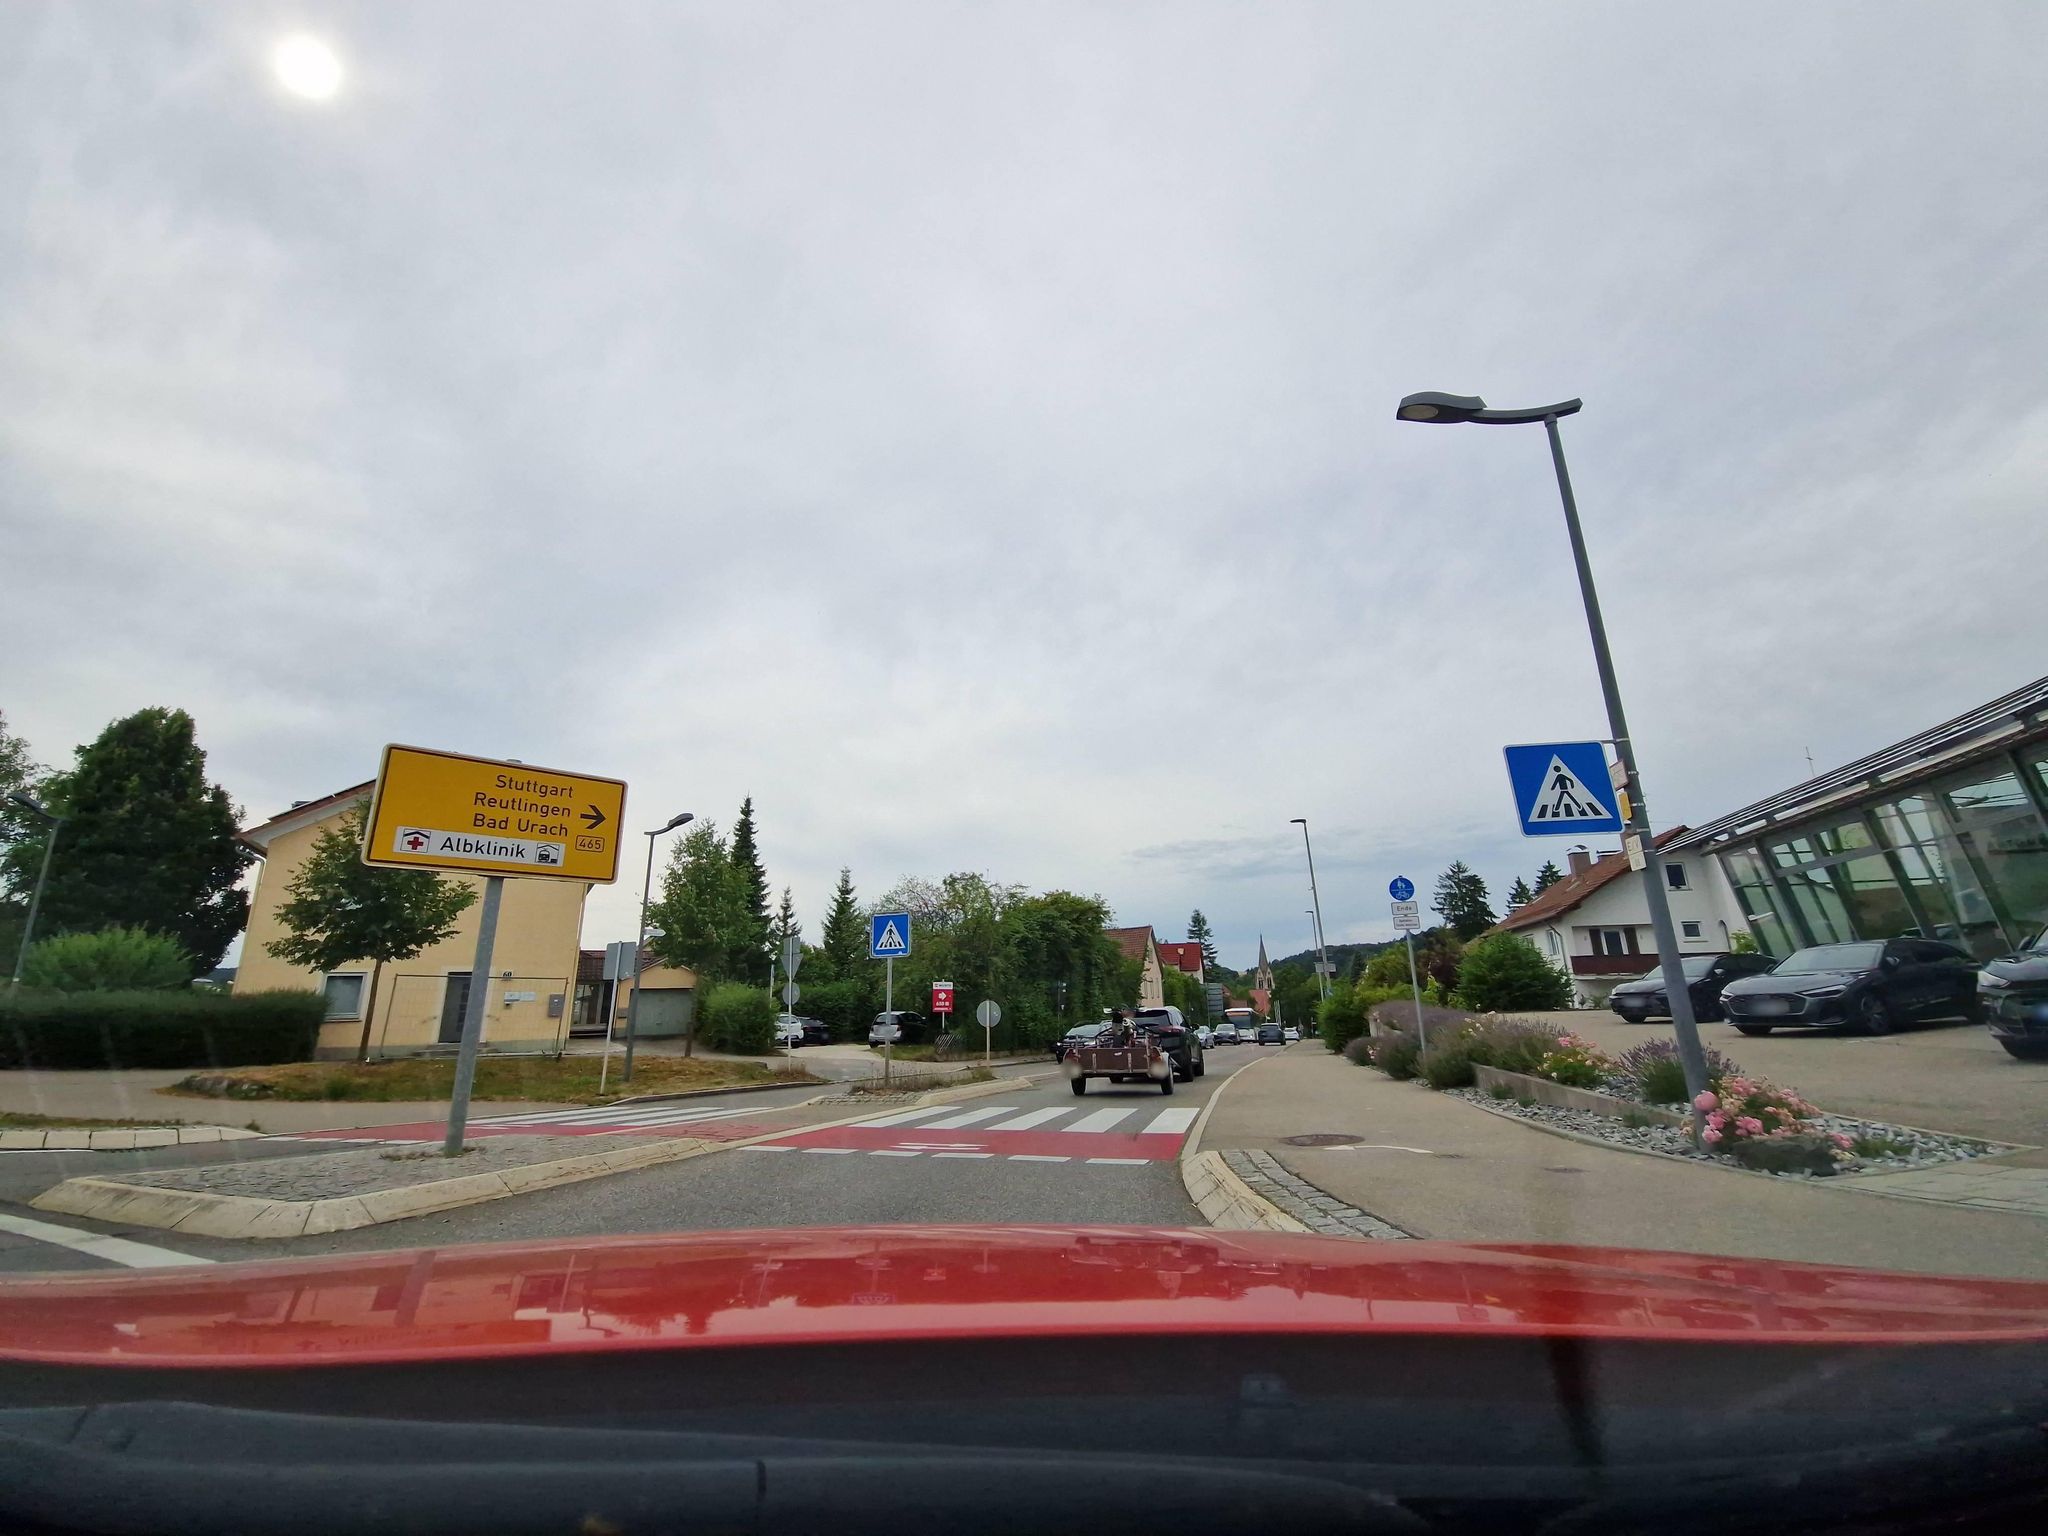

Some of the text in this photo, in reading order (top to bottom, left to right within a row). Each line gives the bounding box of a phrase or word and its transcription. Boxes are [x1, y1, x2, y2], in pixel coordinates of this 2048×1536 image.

[495, 774, 574, 798] Stuttgart
[473, 791, 571, 818] Reutlingen
[473, 813, 568, 837] Bad Urach
[440, 836, 526, 859] Albklinik
[579, 839, 602, 850] 465
